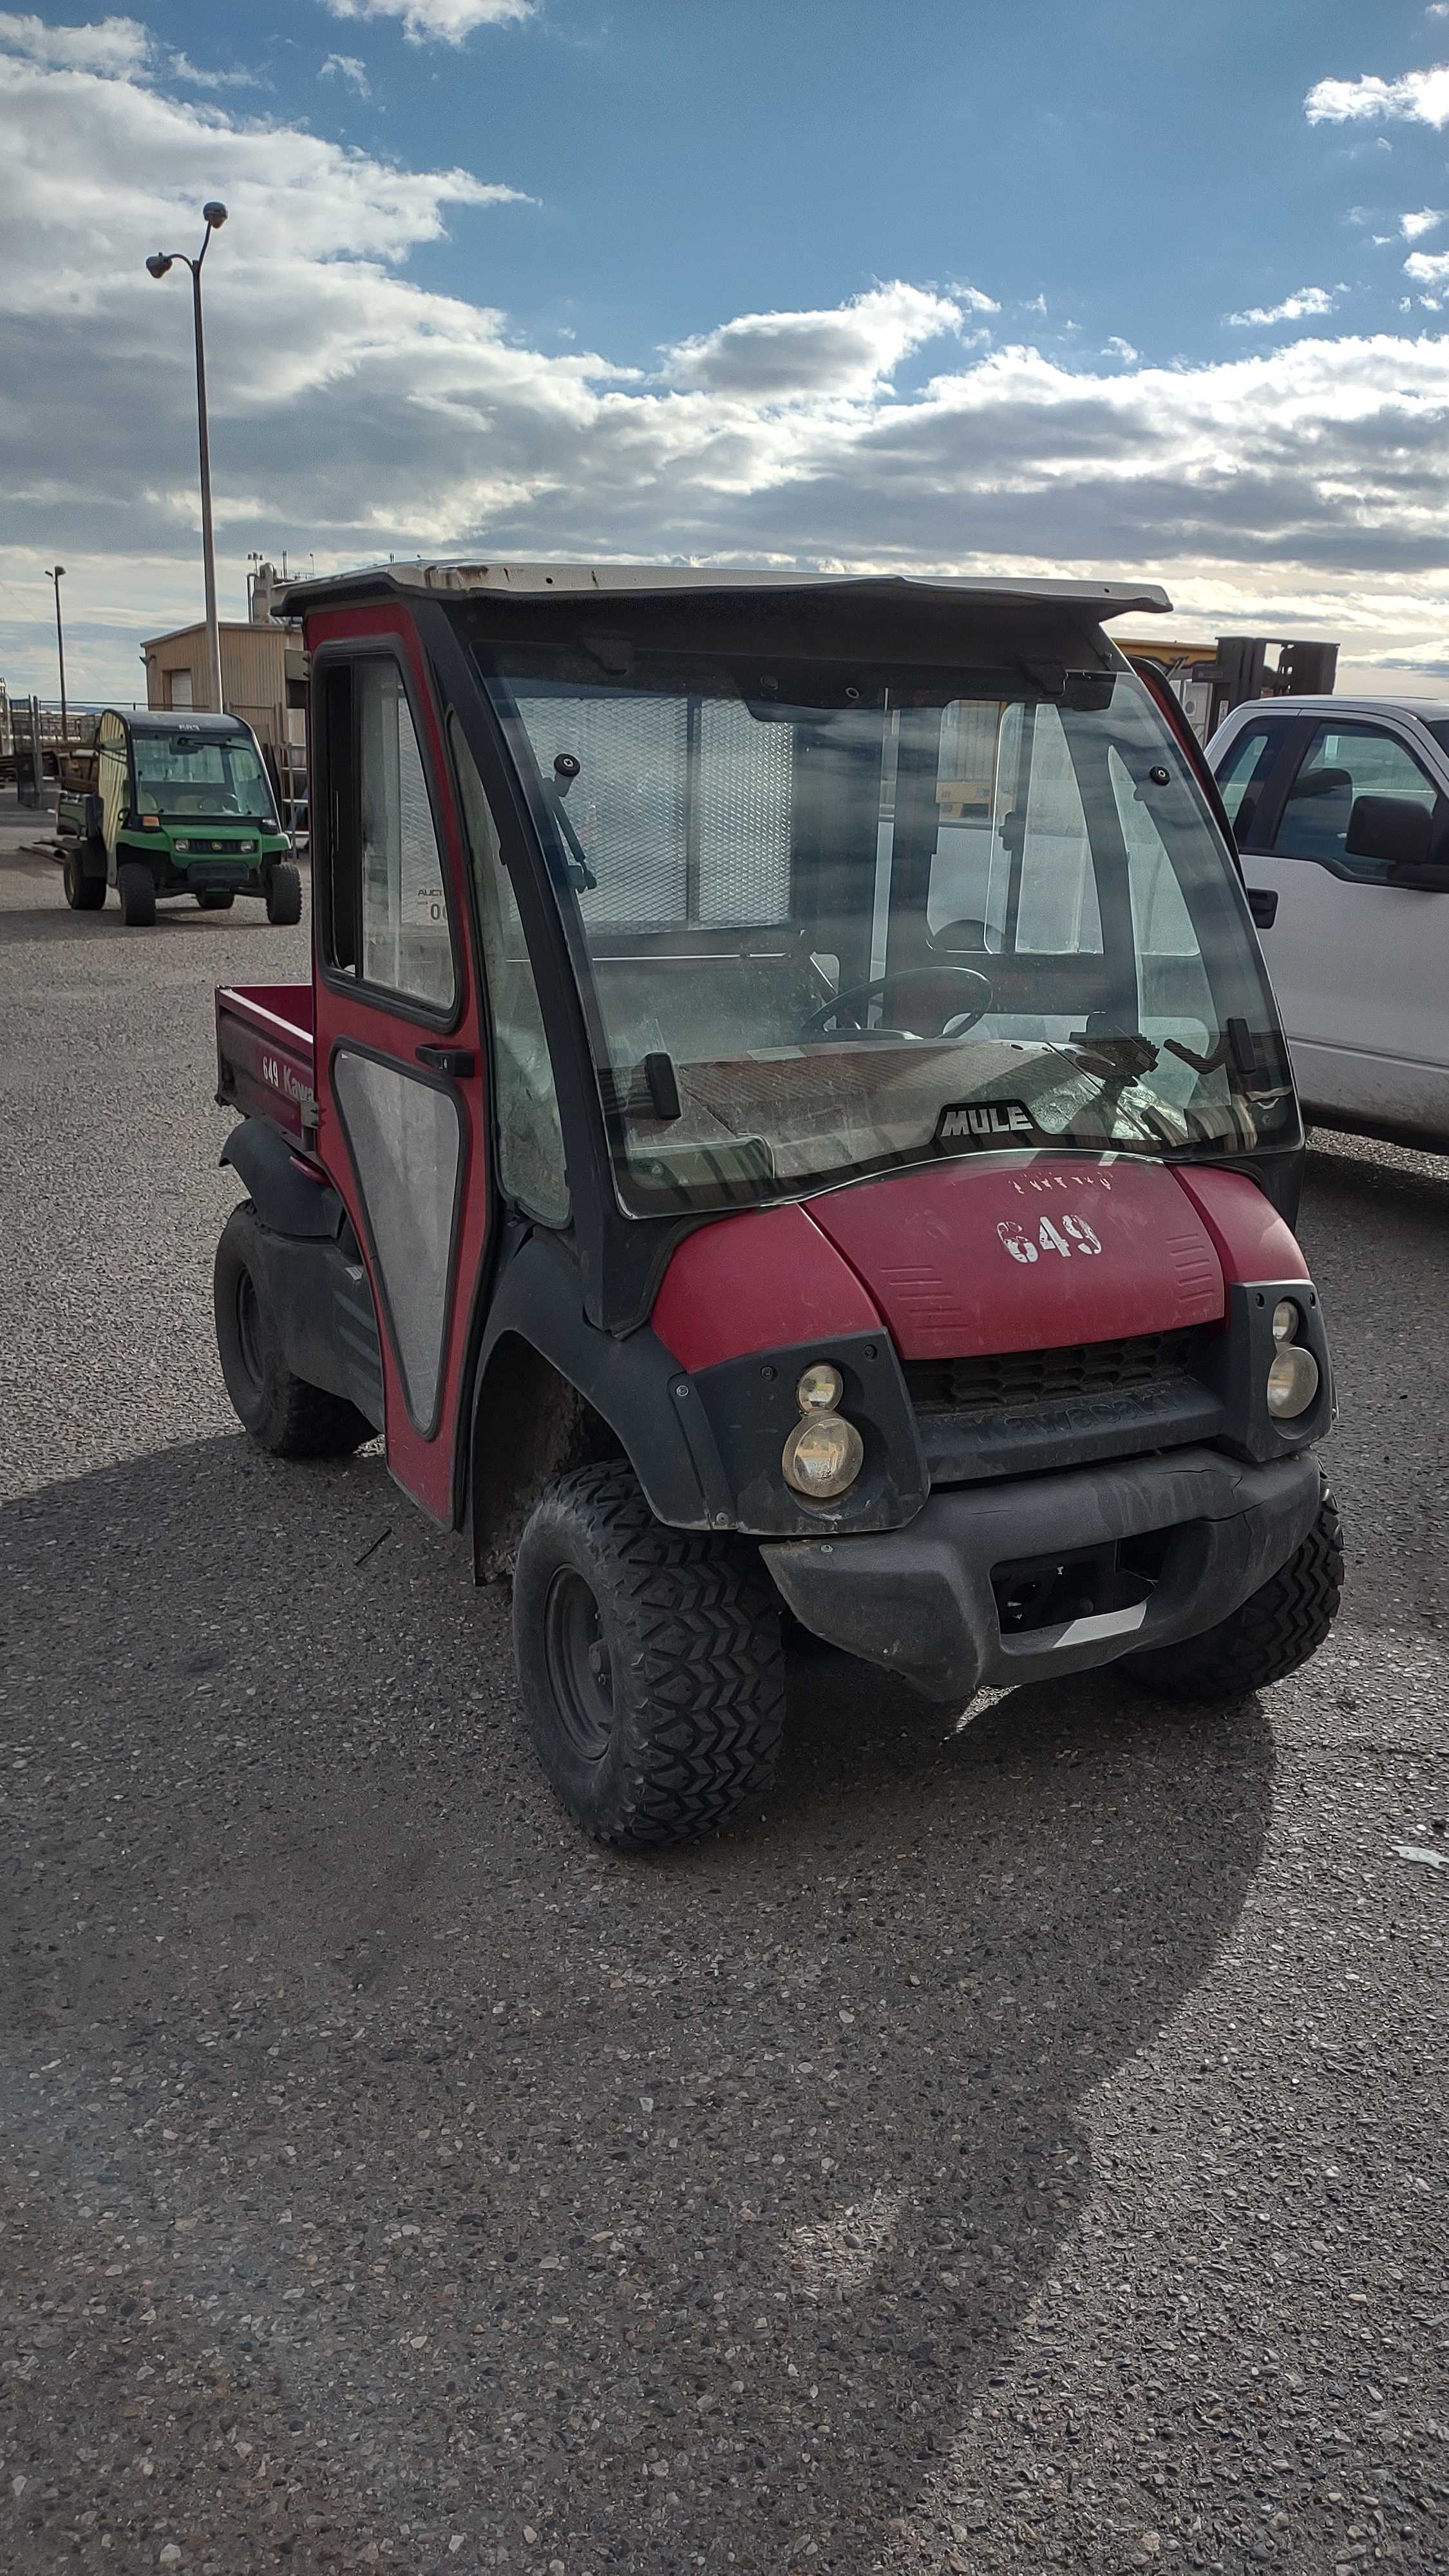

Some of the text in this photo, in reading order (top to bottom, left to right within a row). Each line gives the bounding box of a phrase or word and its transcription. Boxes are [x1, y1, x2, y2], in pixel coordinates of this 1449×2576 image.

[263, 1056, 279, 1088] 649
[940, 1106, 1034, 1137] MULE
[996, 1214, 1103, 1264] 649
